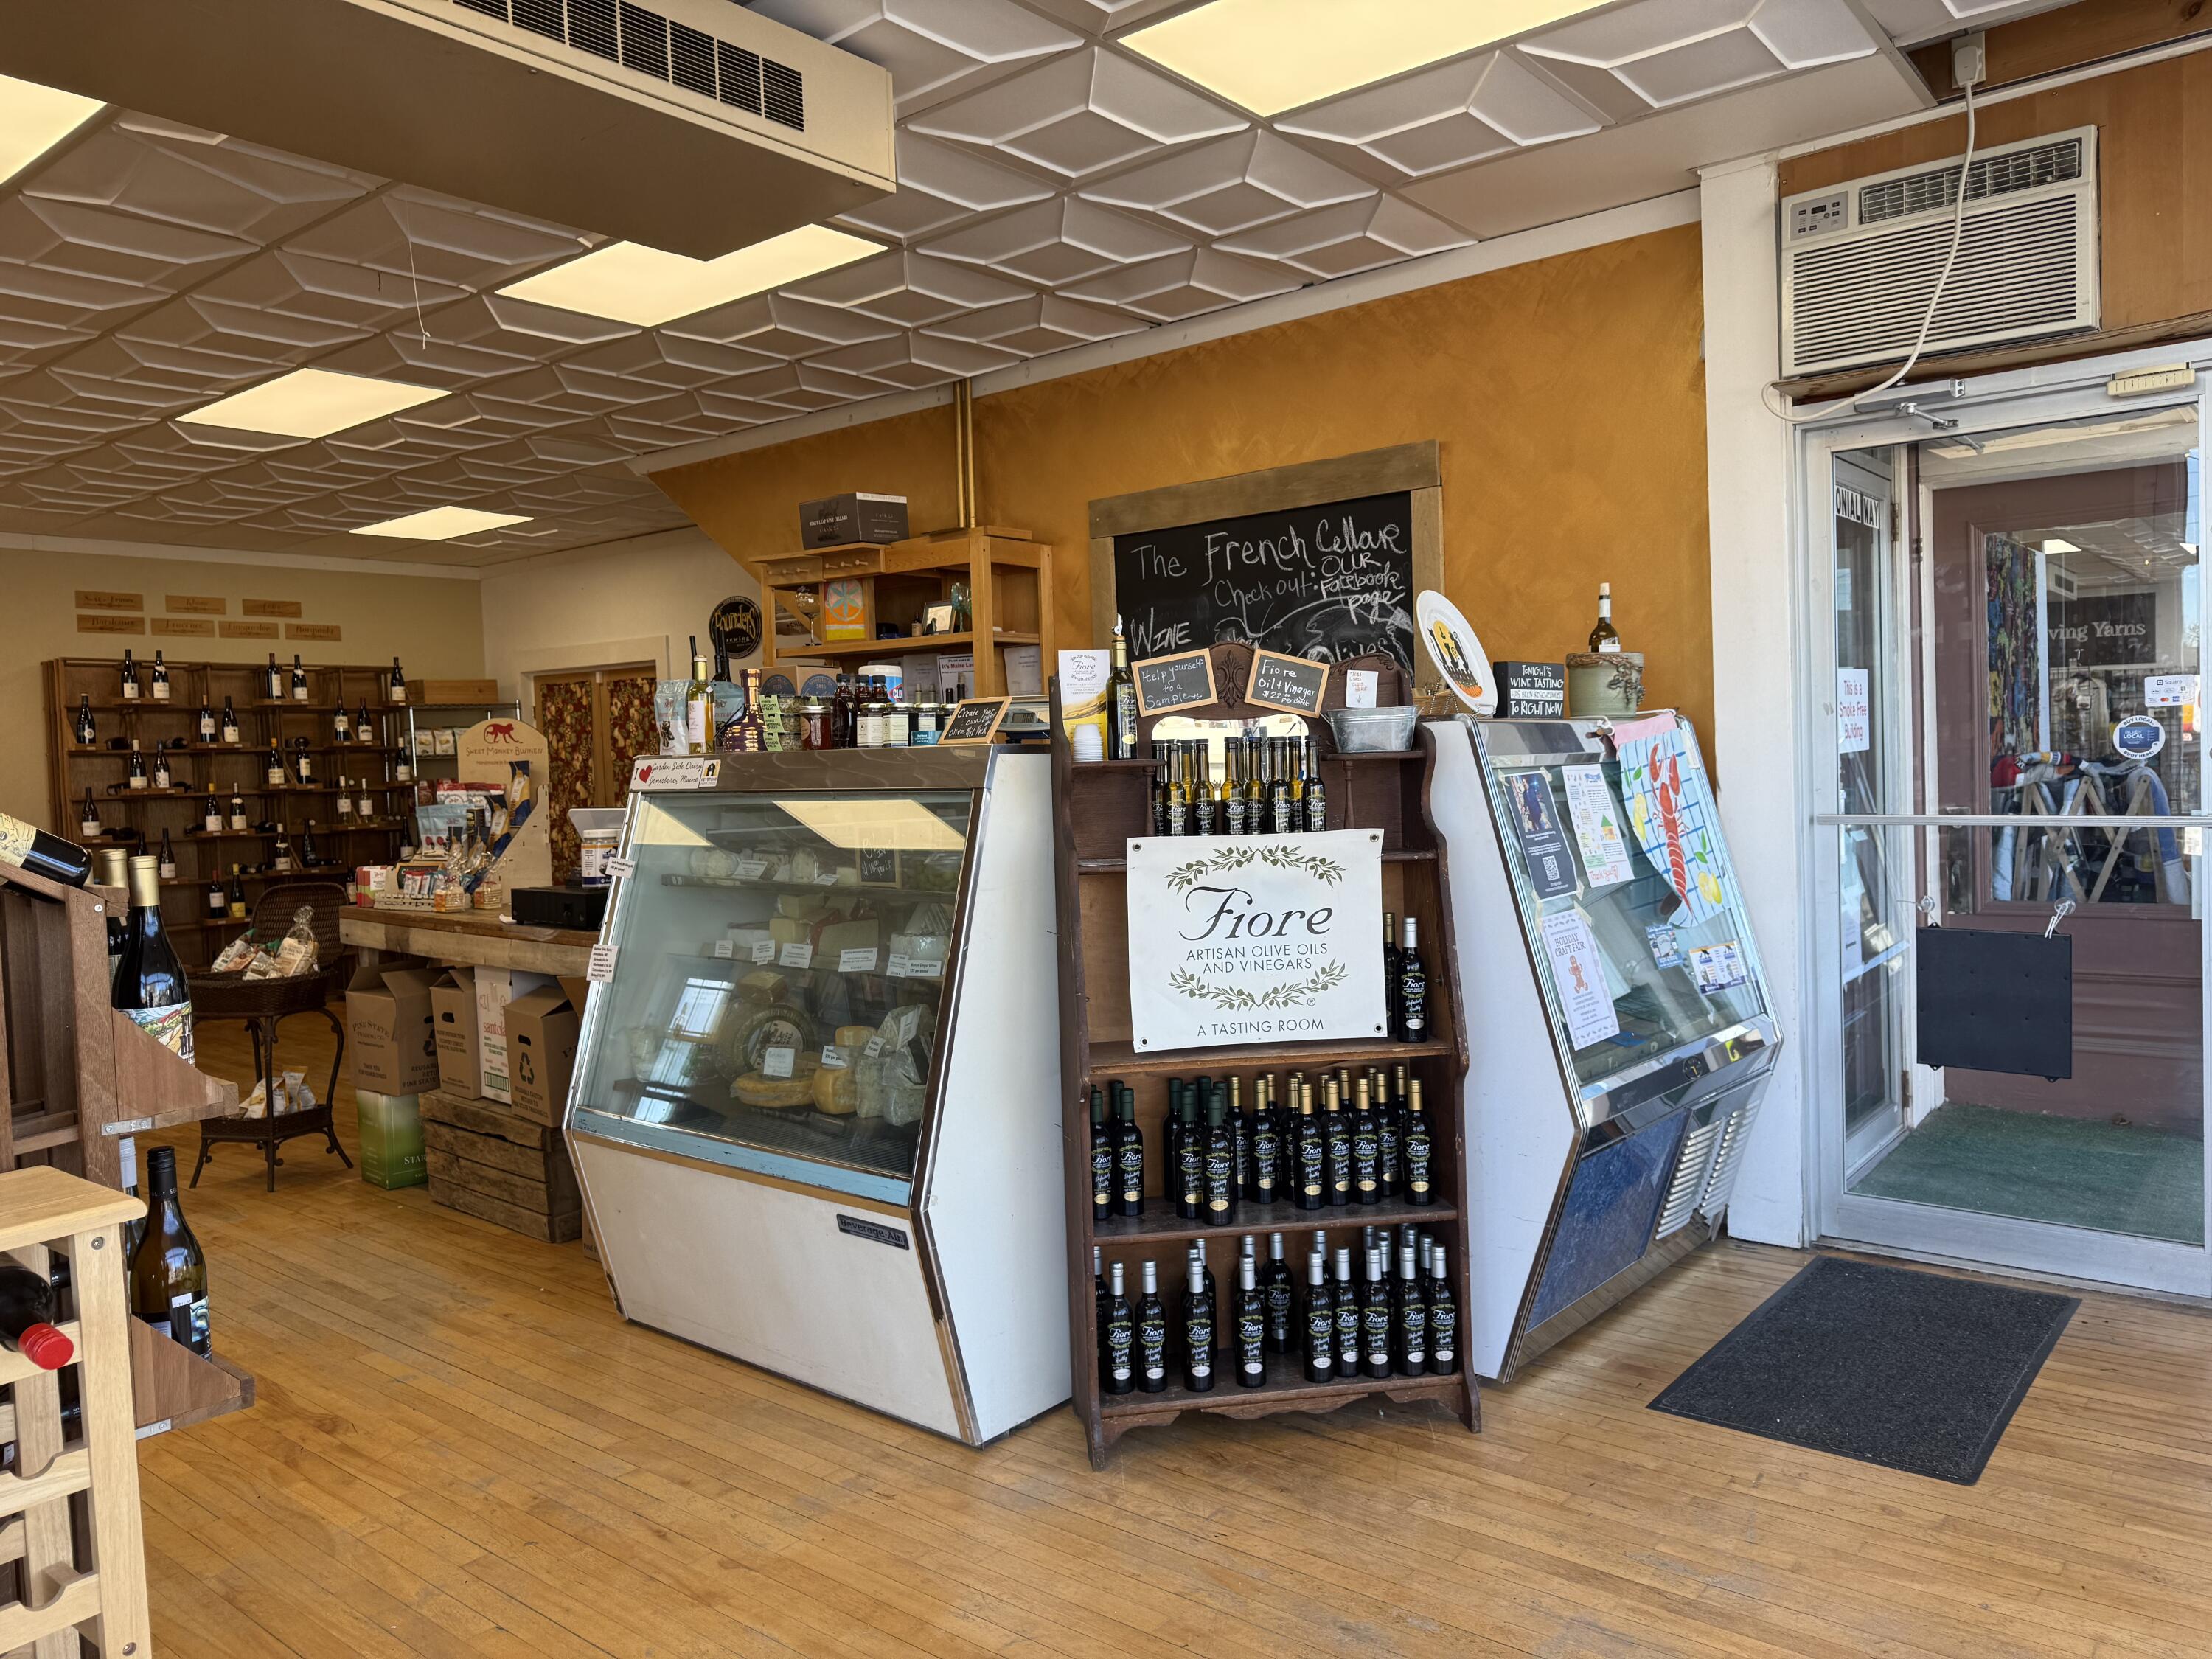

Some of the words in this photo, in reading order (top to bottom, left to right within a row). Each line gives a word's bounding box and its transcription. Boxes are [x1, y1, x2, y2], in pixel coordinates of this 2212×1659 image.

[1863, 498, 1879, 526] WAY
[1130, 544, 1187, 580] The
[1202, 525, 1316, 586] French
[1215, 579, 1272, 607] Check
[1349, 590, 1405, 625] page
[2092, 621, 2146, 637] Yarns
[1072, 661, 1096, 670] Fiore
[1142, 671, 1166, 685] Help
[1169, 658, 1204, 686] yourself
[1262, 660, 1297, 678] Fiore
[1163, 684, 1172, 692] to
[1284, 681, 1315, 697] Vinegar
[1510, 677, 1532, 688] WINE
[1534, 678, 1564, 689] TASTING
[1844, 680, 1852, 695] This
[958, 708, 979, 718] Create
[1520, 700, 1544, 715] RIGHT
[1840, 702, 1855, 717] Smoke
[1857, 702, 1867, 717] Free
[949, 728, 965, 737] Olive
[1845, 723, 1863, 741] Building
[487, 747, 513, 756] MONKEY
[681, 775, 698, 783] Maine
[1178, 886, 1333, 941] Fiore
[1554, 933, 1579, 947] HOLIDAY
[1186, 946, 1245, 961] ARTISAN
[1251, 945, 1290, 957] OLIVE
[1297, 943, 1328, 956] OILS
[1555, 944, 1572, 957] CRAFT
[1573, 942, 1586, 953] FAIR
[1203, 961, 1234, 974] AND
[1241, 958, 1312, 972] VINEGARS
[1402, 978, 1425, 988] Fiore
[353, 1022, 366, 1032] PINE
[367, 1020, 389, 1037] STATE
[1197, 1026, 1207, 1037] A
[1211, 1020, 1273, 1035] TASTING
[1279, 1018, 1324, 1032] ROOM
